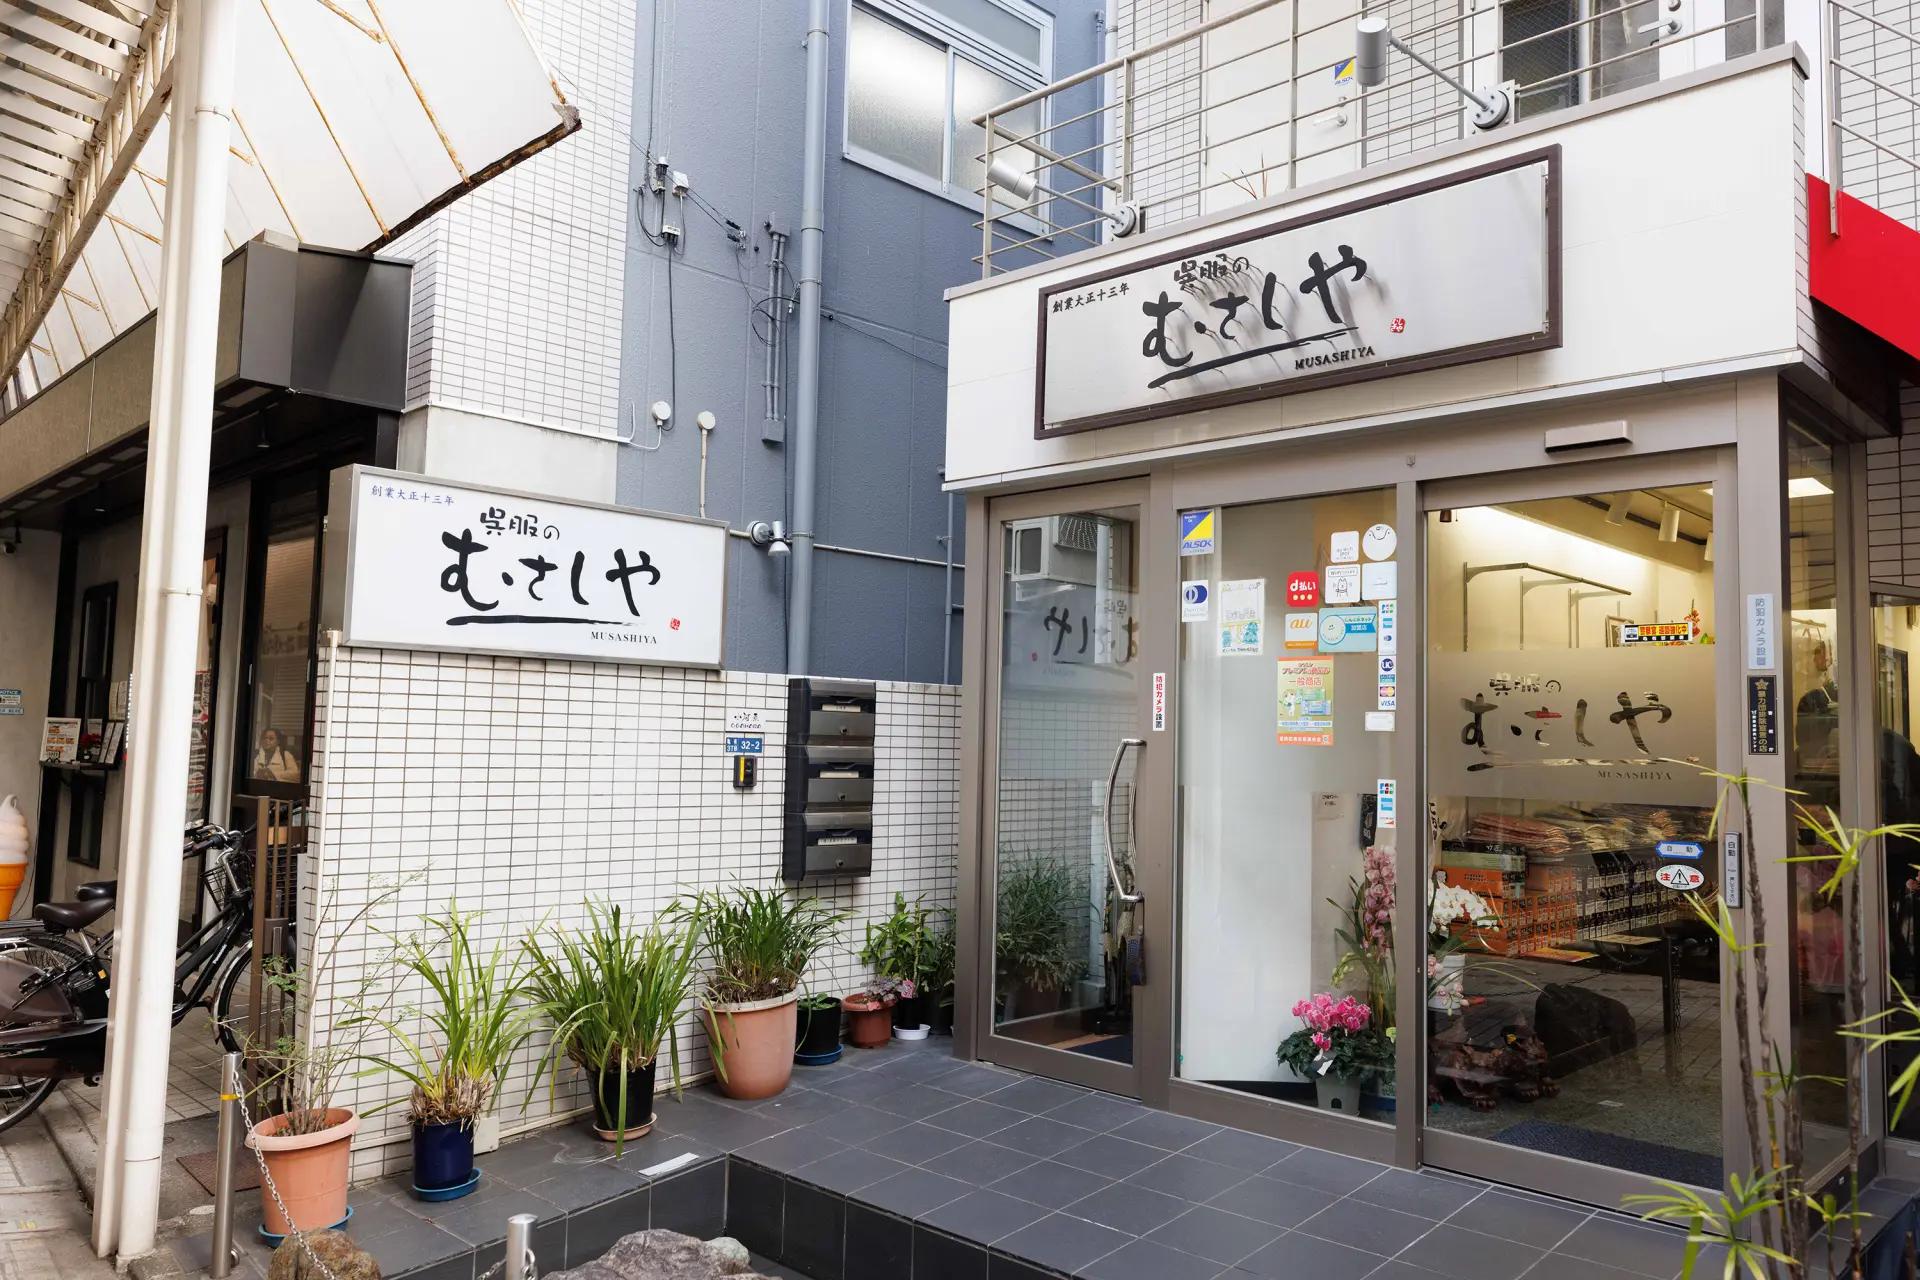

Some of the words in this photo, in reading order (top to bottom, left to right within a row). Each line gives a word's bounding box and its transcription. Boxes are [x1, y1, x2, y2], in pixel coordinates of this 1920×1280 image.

[1173, 253, 1250, 292] 呉服の
[1052, 282, 1131, 315] 創業大正十三年
[1142, 244, 1368, 368] むさしや
[1294, 345, 1376, 370] MUSASHIYA
[371, 484, 455, 506] 創業大正十三年
[479, 506, 560, 541] 呉服の
[1182, 540, 1212, 550] ALSOK
[440, 528, 661, 617] むさしや
[1289, 578, 1317, 593] d払い
[1289, 618, 1313, 630] au
[1755, 598, 1767, 667] 防犯カメラ設置
[590, 631, 658, 645] MUSASHIYA
[1155, 675, 1163, 729] 防犯カメラ設置
[1380, 700, 1395, 708] VISA
[740, 740, 761, 750] 32-2
[1597, 769, 1673, 781] MUSASHIYA
[1727, 841, 1736, 857] 自動
[1660, 872, 1700, 883] 注意
